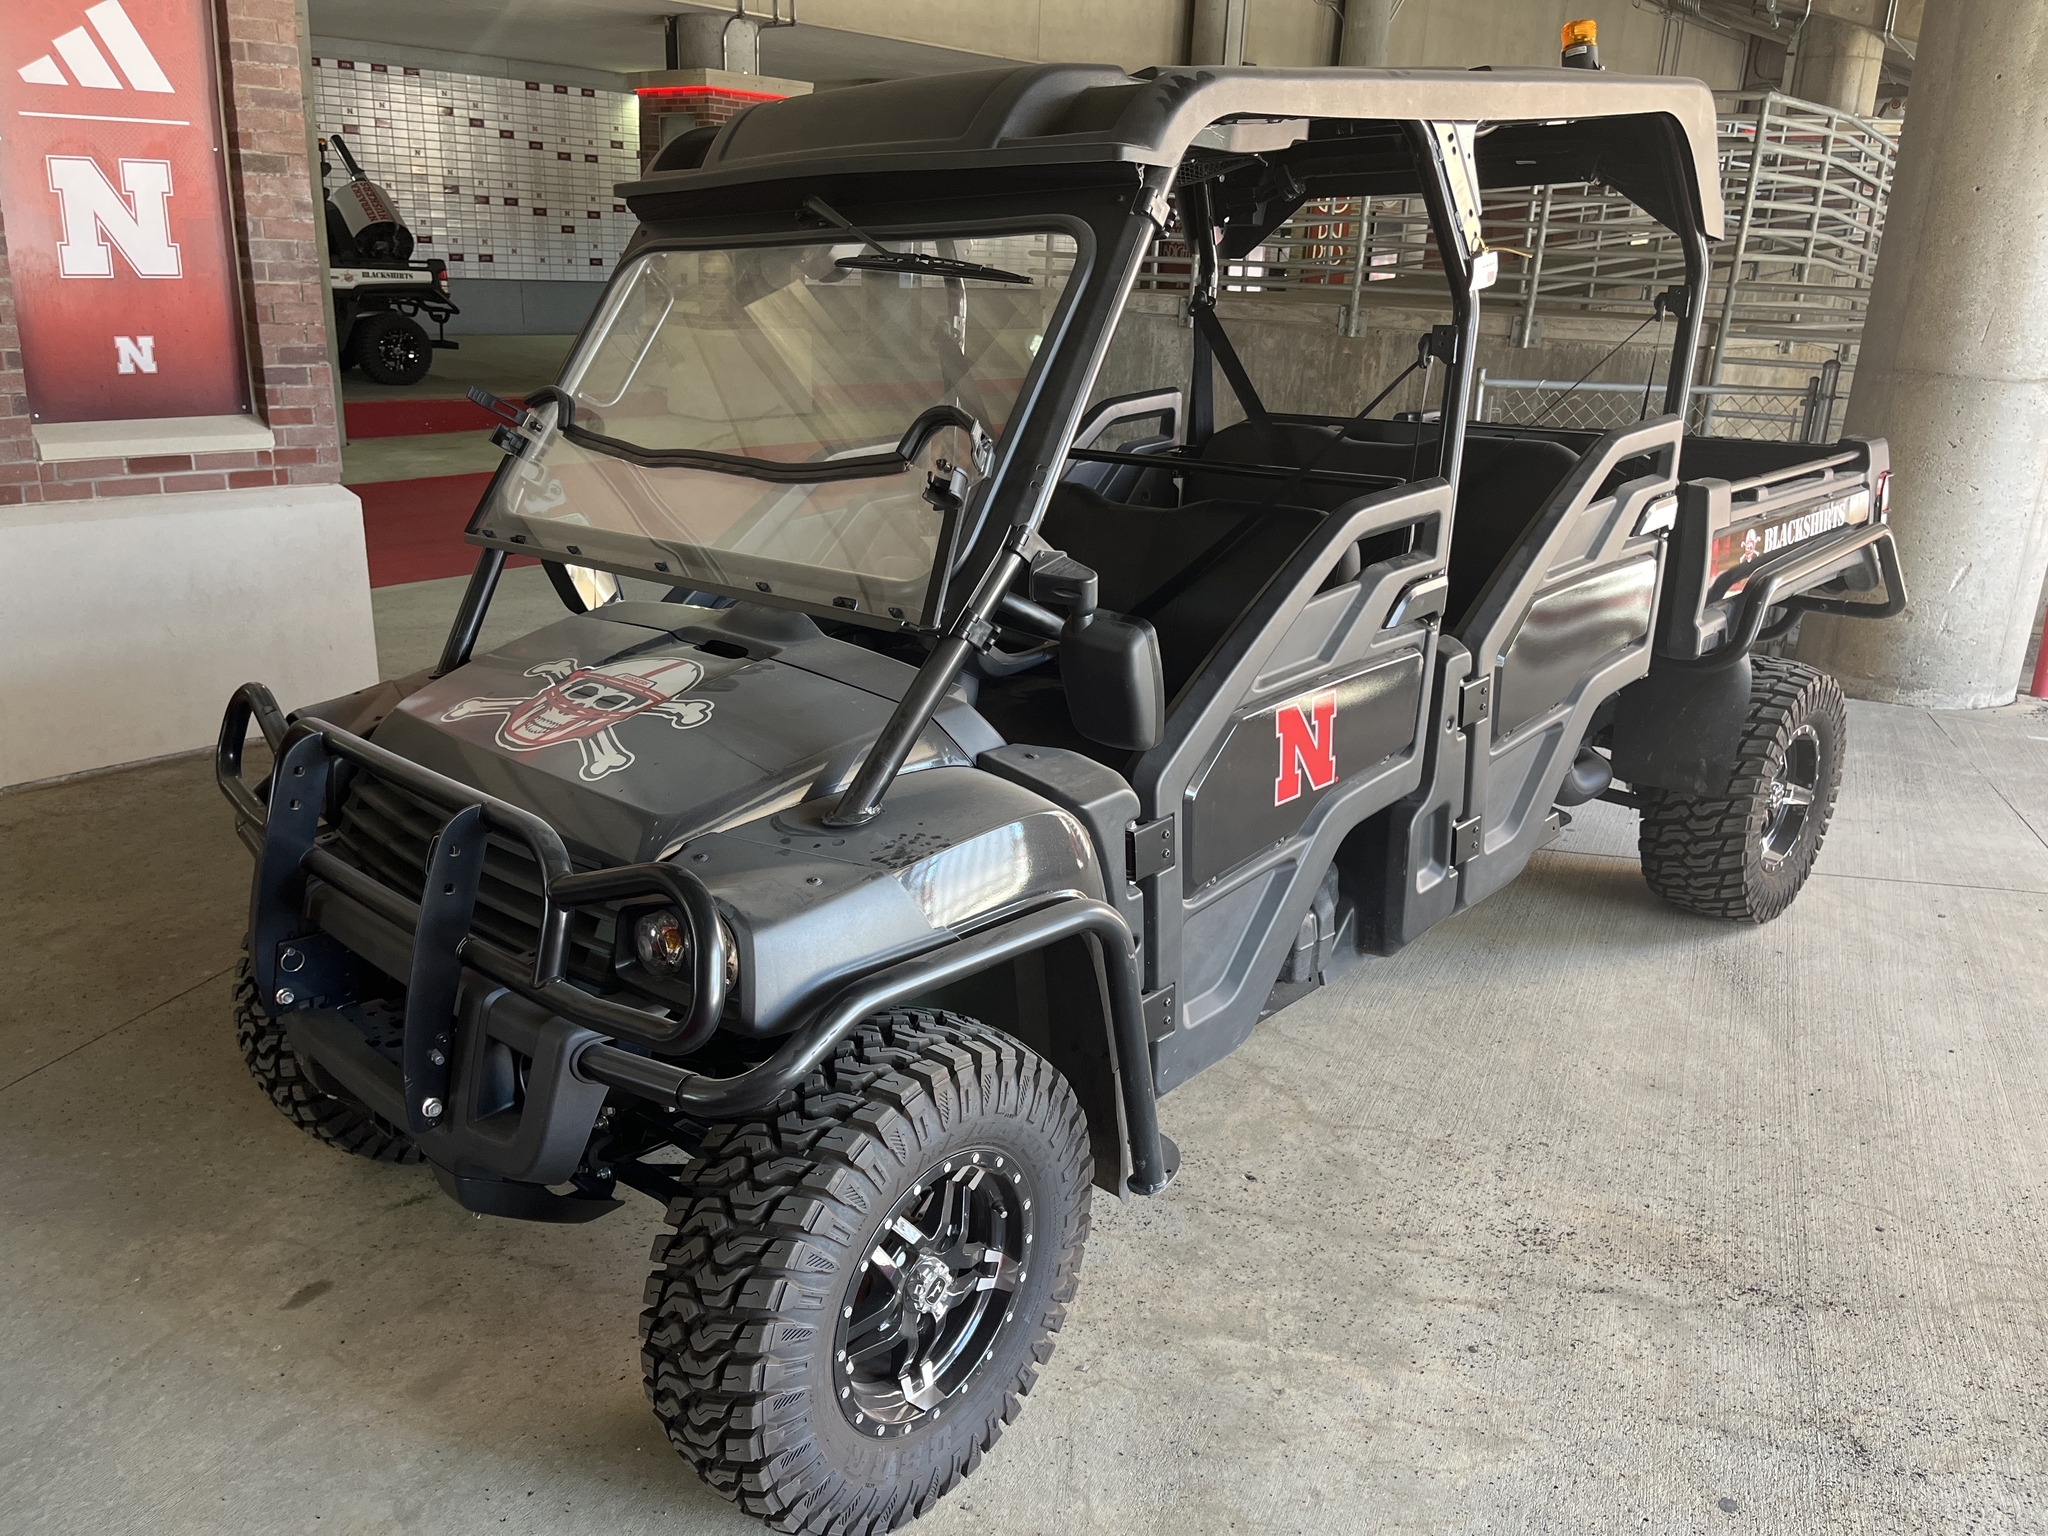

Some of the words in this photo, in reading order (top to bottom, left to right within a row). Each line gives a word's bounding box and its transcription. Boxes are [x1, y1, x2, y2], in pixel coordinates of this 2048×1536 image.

[45, 154, 183, 279] N
[351, 183, 378, 222] NEBRASKA
[360, 181, 390, 220] HUSKERS
[362, 271, 414, 280] BLACKSHIRTS
[113, 335, 158, 375] N
[1763, 502, 1846, 554] BLACKSHIRTS
[1274, 688, 1337, 808] N
